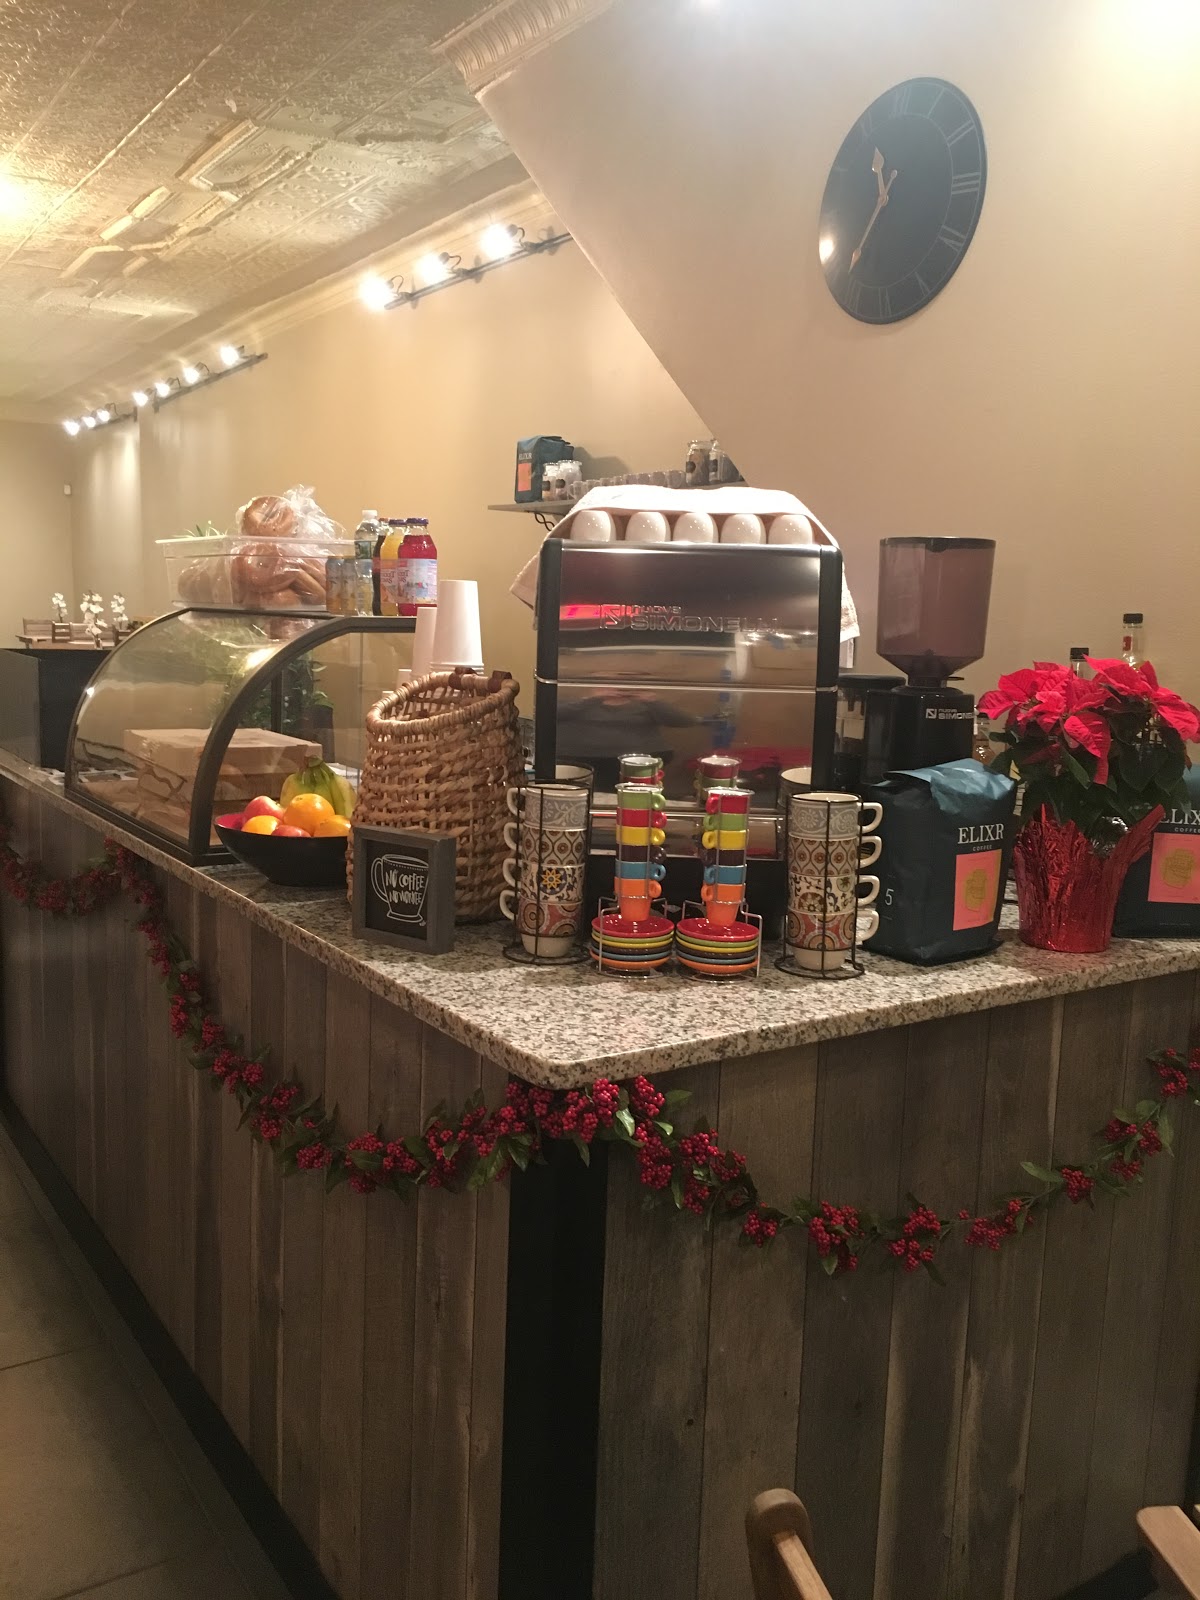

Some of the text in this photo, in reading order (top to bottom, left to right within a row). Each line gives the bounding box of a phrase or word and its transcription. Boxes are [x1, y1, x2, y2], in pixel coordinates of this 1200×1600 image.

[957, 823, 1004, 845] ELIXR
[972, 844, 993, 852] COFFEE
[385, 868, 425, 891] NO COFFEE
[884, 888, 894, 906] 5
